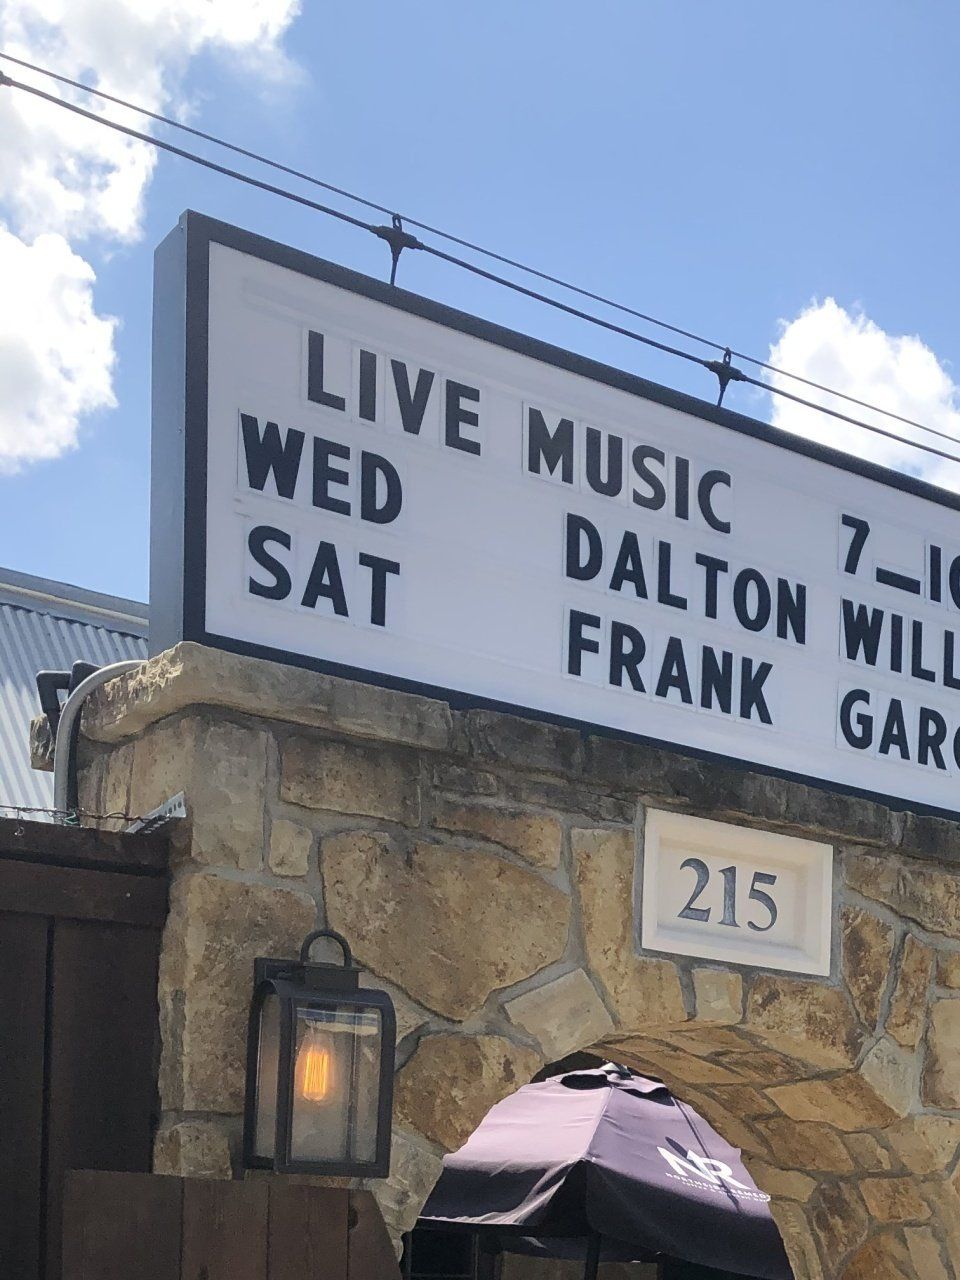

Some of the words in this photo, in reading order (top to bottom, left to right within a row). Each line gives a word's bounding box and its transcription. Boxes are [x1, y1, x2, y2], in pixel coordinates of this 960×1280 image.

[240, 412, 403, 525] WED
[565, 512, 807, 645] DALTON
[307, 329, 481, 457] LIVE
[528, 407, 731, 534] MUSIC
[247, 525, 401, 627] SAT
[567, 608, 774, 725] FRANK
[677, 857, 778, 932] 215
